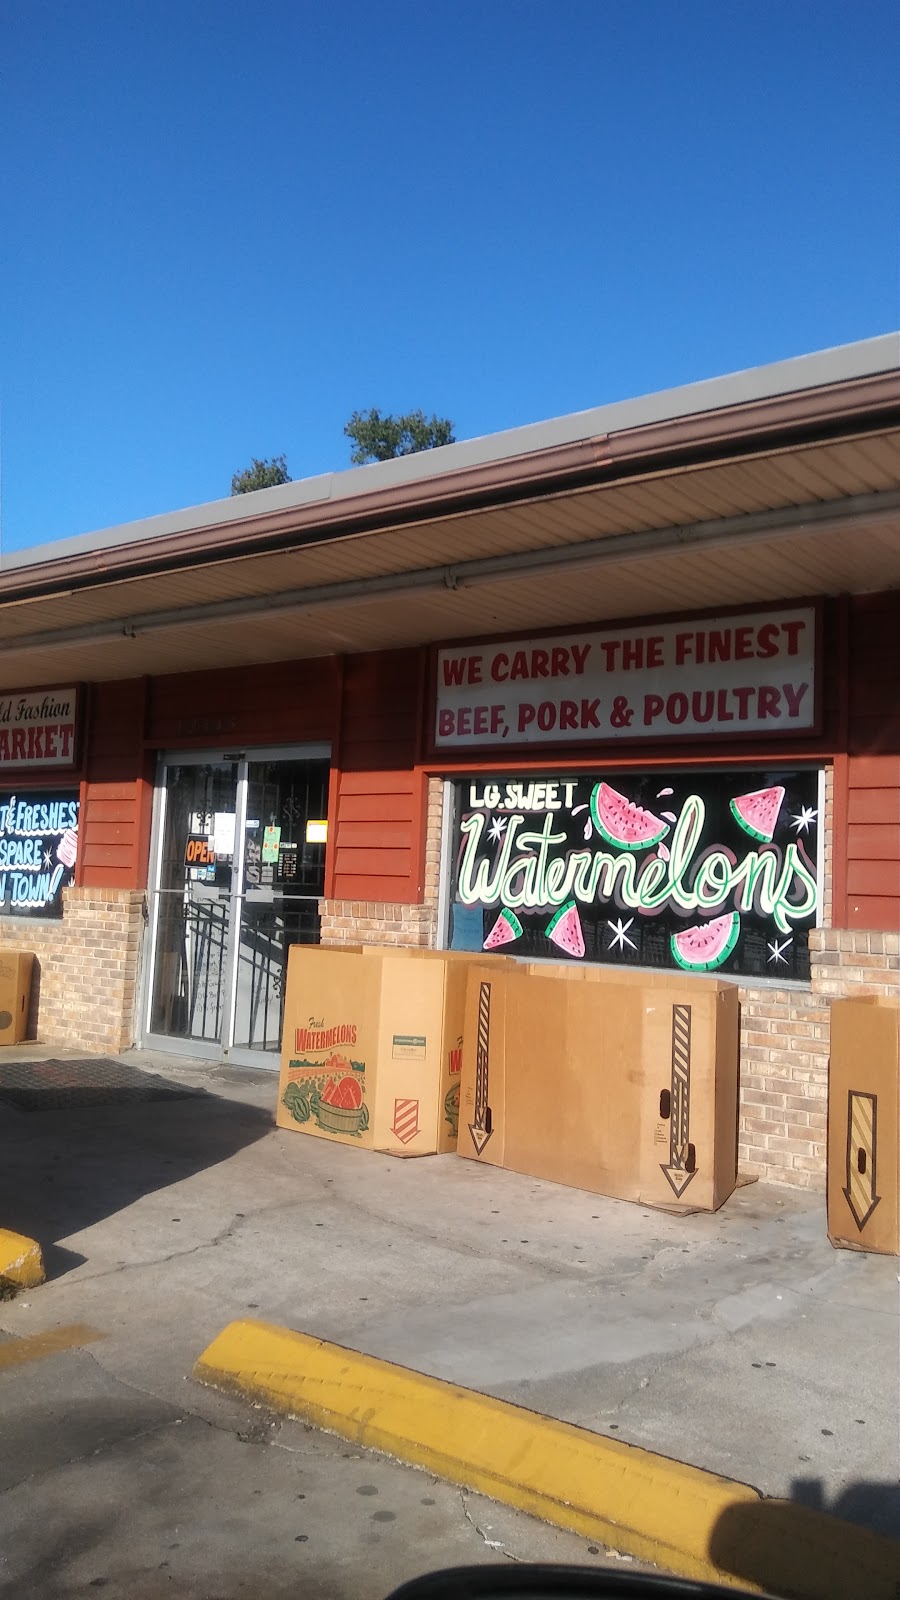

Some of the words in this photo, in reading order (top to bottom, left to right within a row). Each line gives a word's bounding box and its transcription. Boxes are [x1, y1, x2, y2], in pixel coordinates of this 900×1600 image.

[442, 655, 483, 687] WE
[490, 643, 592, 682] CARRY
[601, 635, 665, 672] THE
[675, 621, 806, 666] FINEST
[15, 696, 70, 721] Fashion
[438, 704, 510, 738] BEEF,
[517, 698, 601, 733] PORK
[610, 695, 635, 728] &
[643, 682, 809, 726] POULTRY
[16, 801, 80, 831] FRESHES
[458, 794, 819, 934] Watermelons
[294, 1023, 357, 1055] WATERMELONS
